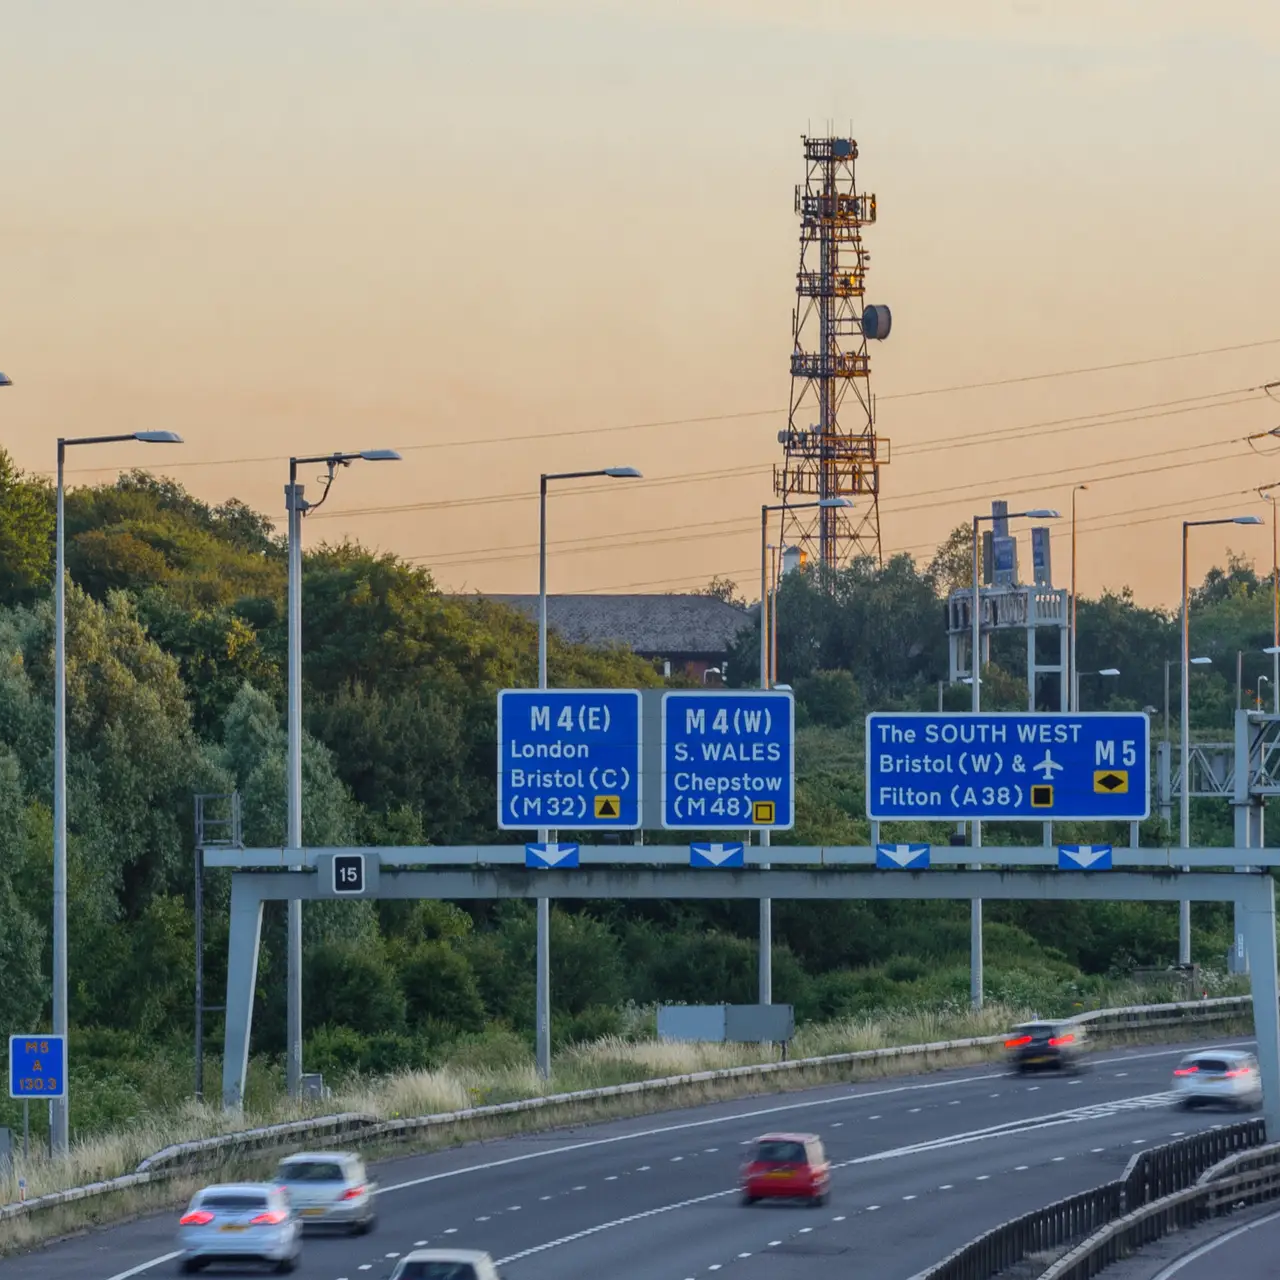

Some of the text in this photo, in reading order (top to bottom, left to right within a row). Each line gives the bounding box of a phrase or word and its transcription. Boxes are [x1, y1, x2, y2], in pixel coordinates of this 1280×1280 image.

[878, 724, 1081, 743] The SOUTH WEST
[512, 740, 588, 758] London
[675, 743, 780, 761] S. WALES
[880, 752, 1025, 775] Bristol (W) &
[512, 767, 629, 790] Bristol (C)
[675, 773, 781, 794] Chepstow
[880, 787, 941, 805] Filton
[340, 868, 357, 881] 15
[32, 1060, 42, 1072] A
